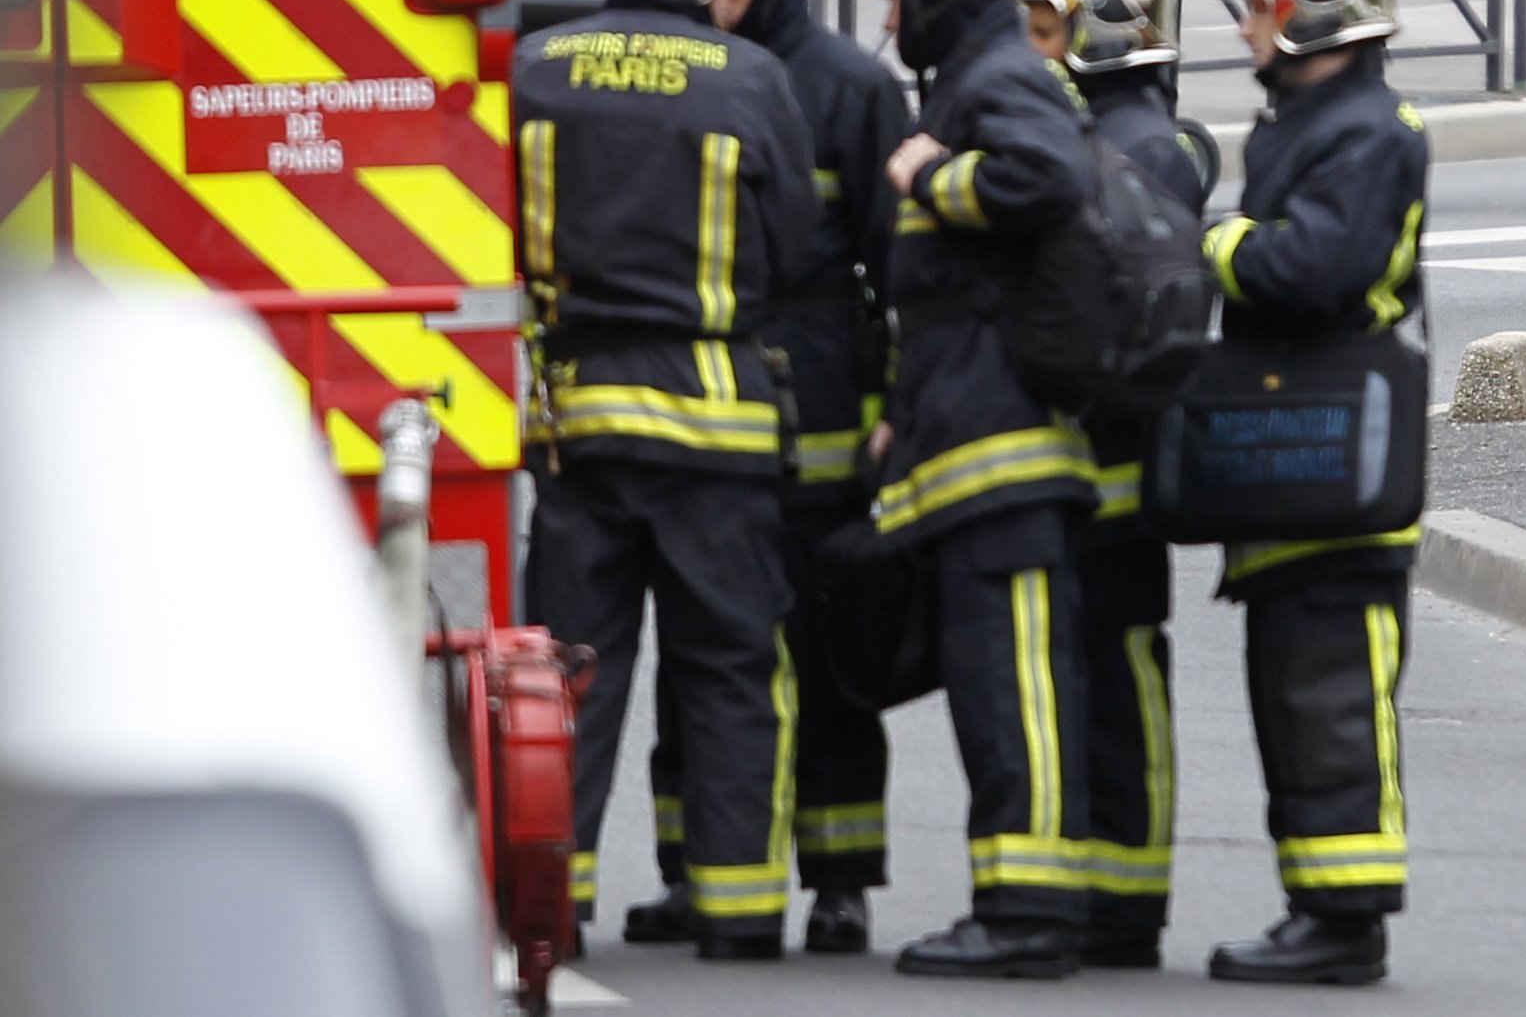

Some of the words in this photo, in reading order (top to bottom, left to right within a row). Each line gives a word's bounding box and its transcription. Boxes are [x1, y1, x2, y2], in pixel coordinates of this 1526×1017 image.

[569, 53, 688, 95] PARIS
[286, 113, 324, 145] DE
[267, 140, 344, 175] PARIS
